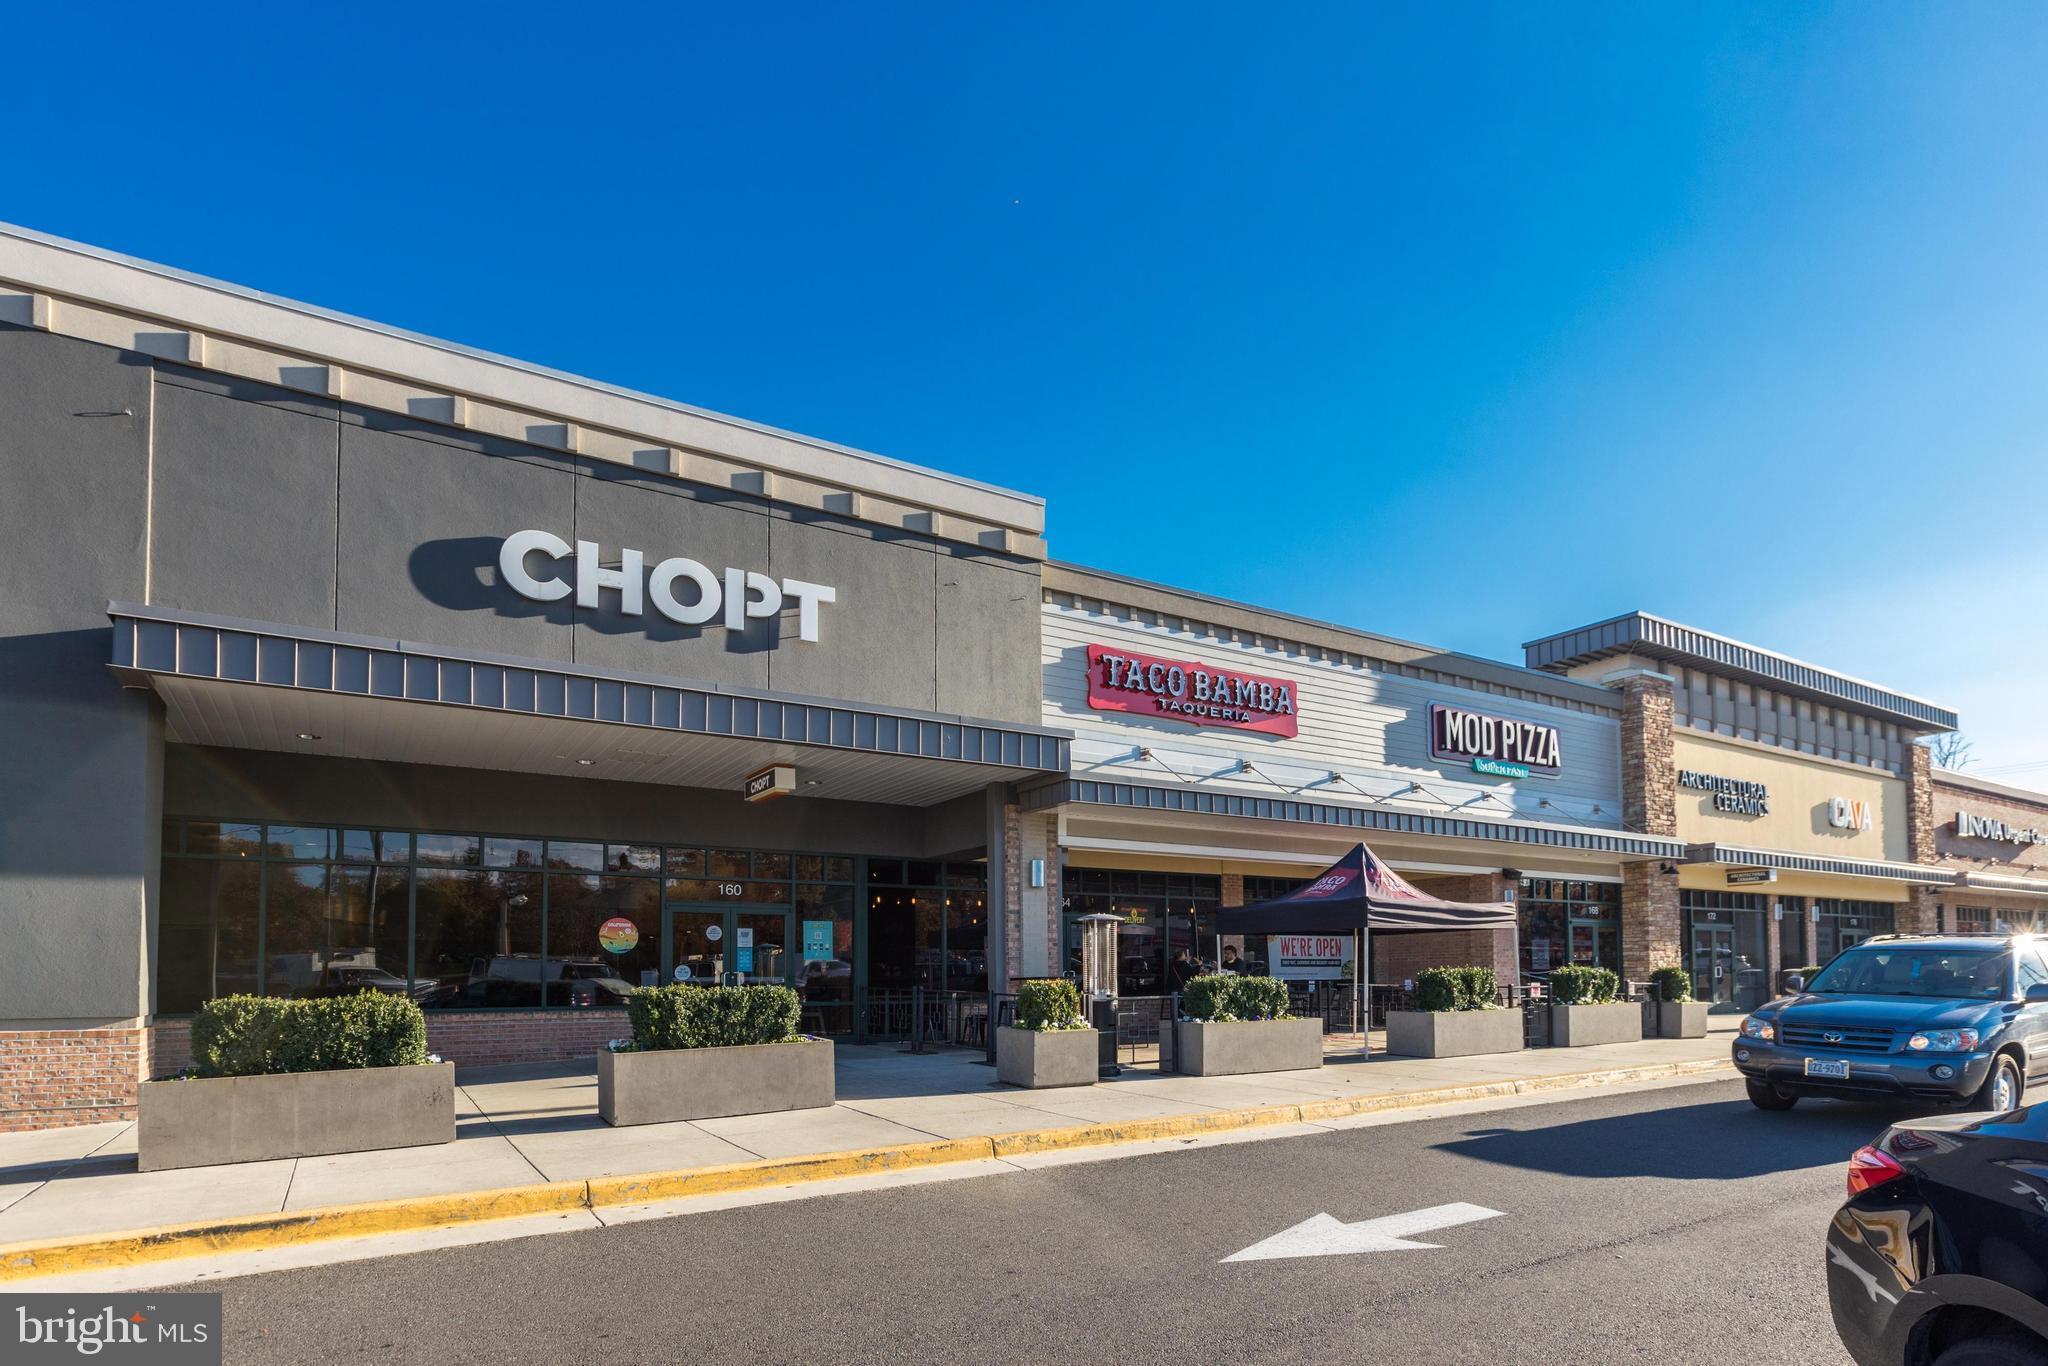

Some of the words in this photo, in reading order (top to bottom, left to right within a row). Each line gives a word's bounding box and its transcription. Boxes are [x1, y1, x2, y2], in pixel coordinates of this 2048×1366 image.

[500, 529, 836, 643] CHOPT
[1103, 653, 1185, 697] TACO
[1194, 670, 1294, 715] BAMBA
[1158, 698, 1251, 722] TAQUERIA
[1445, 708, 1496, 756] MOD
[1501, 719, 1561, 767] PIZZA
[750, 774, 770, 794] CHOPT
[1679, 770, 1769, 799] ARCHITECTURAL
[1715, 793, 1769, 817] CERAMICS
[1834, 796, 1872, 832] CAVA
[1957, 810, 2005, 841] INOVA
[718, 883, 742, 896] 160
[1588, 906, 1600, 915] 168
[1707, 912, 1717, 920] 172
[1281, 937, 1313, 957] WE'RE
[1315, 938, 1342, 957] OPEN
